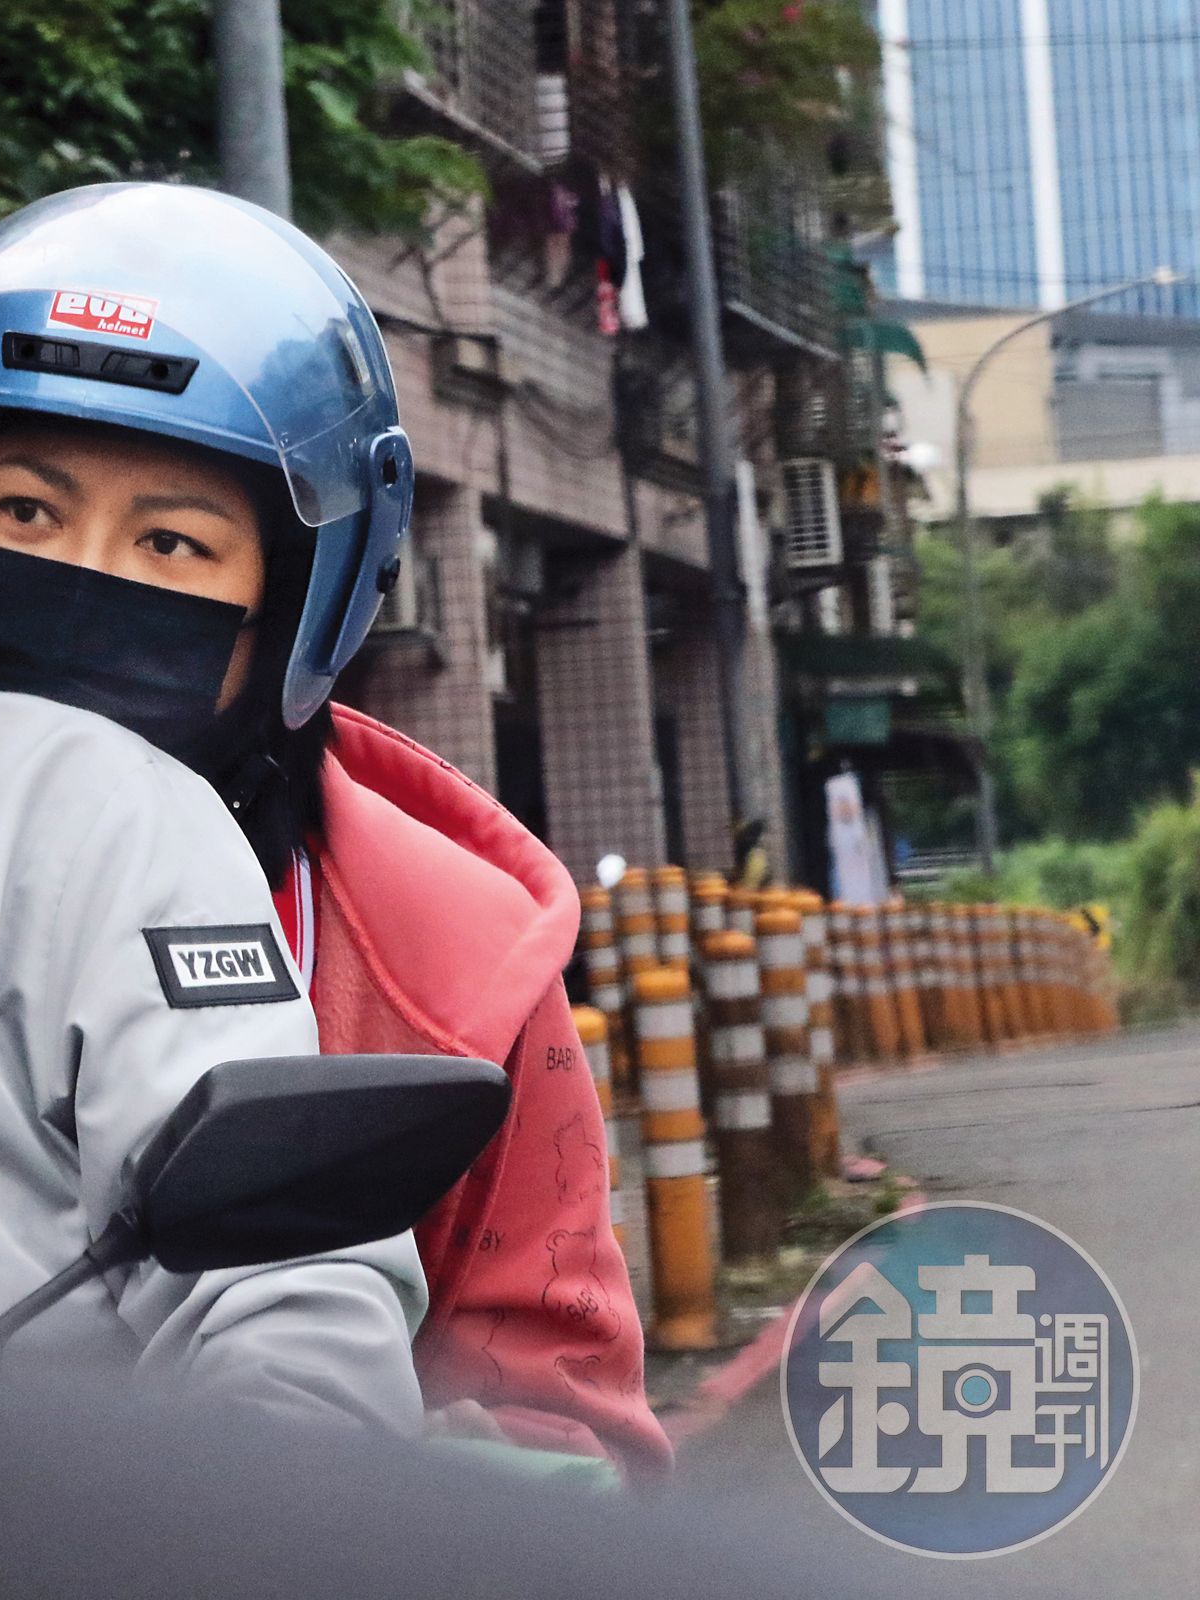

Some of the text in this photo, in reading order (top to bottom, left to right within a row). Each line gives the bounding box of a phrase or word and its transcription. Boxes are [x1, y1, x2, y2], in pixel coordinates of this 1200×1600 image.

[98, 318, 145, 337] helmet
[176, 948, 266, 980] YZGW
[546, 1046, 577, 1072] BABY
[479, 1228, 506, 1252] BY
[566, 1284, 599, 1320] BABY
